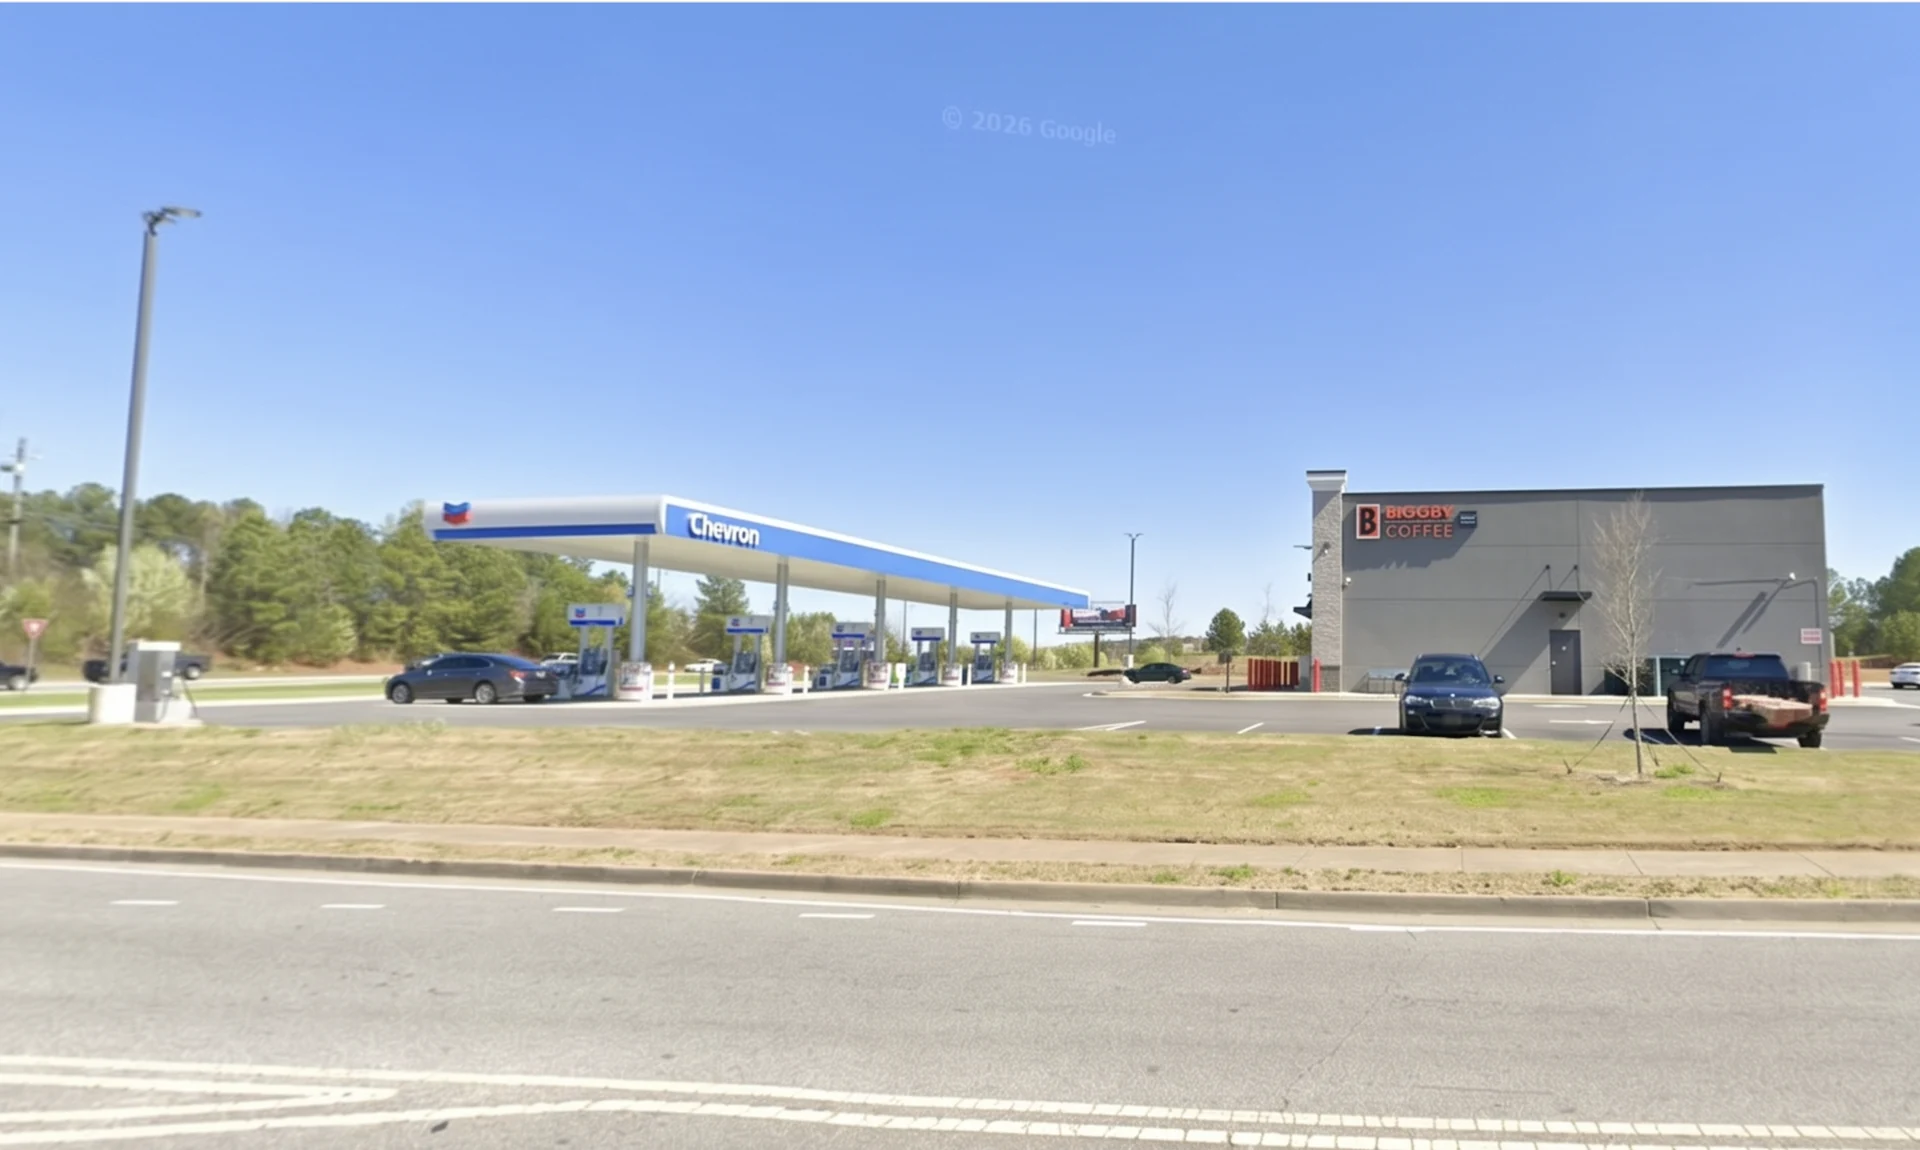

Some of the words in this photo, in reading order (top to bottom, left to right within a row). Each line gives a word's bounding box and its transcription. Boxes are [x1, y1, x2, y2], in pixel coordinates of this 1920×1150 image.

[1360, 506, 1377, 536] B
[1386, 504, 1454, 519] BIGGBY
[687, 512, 760, 546] Chevron
[1386, 524, 1453, 538] COFFEE
